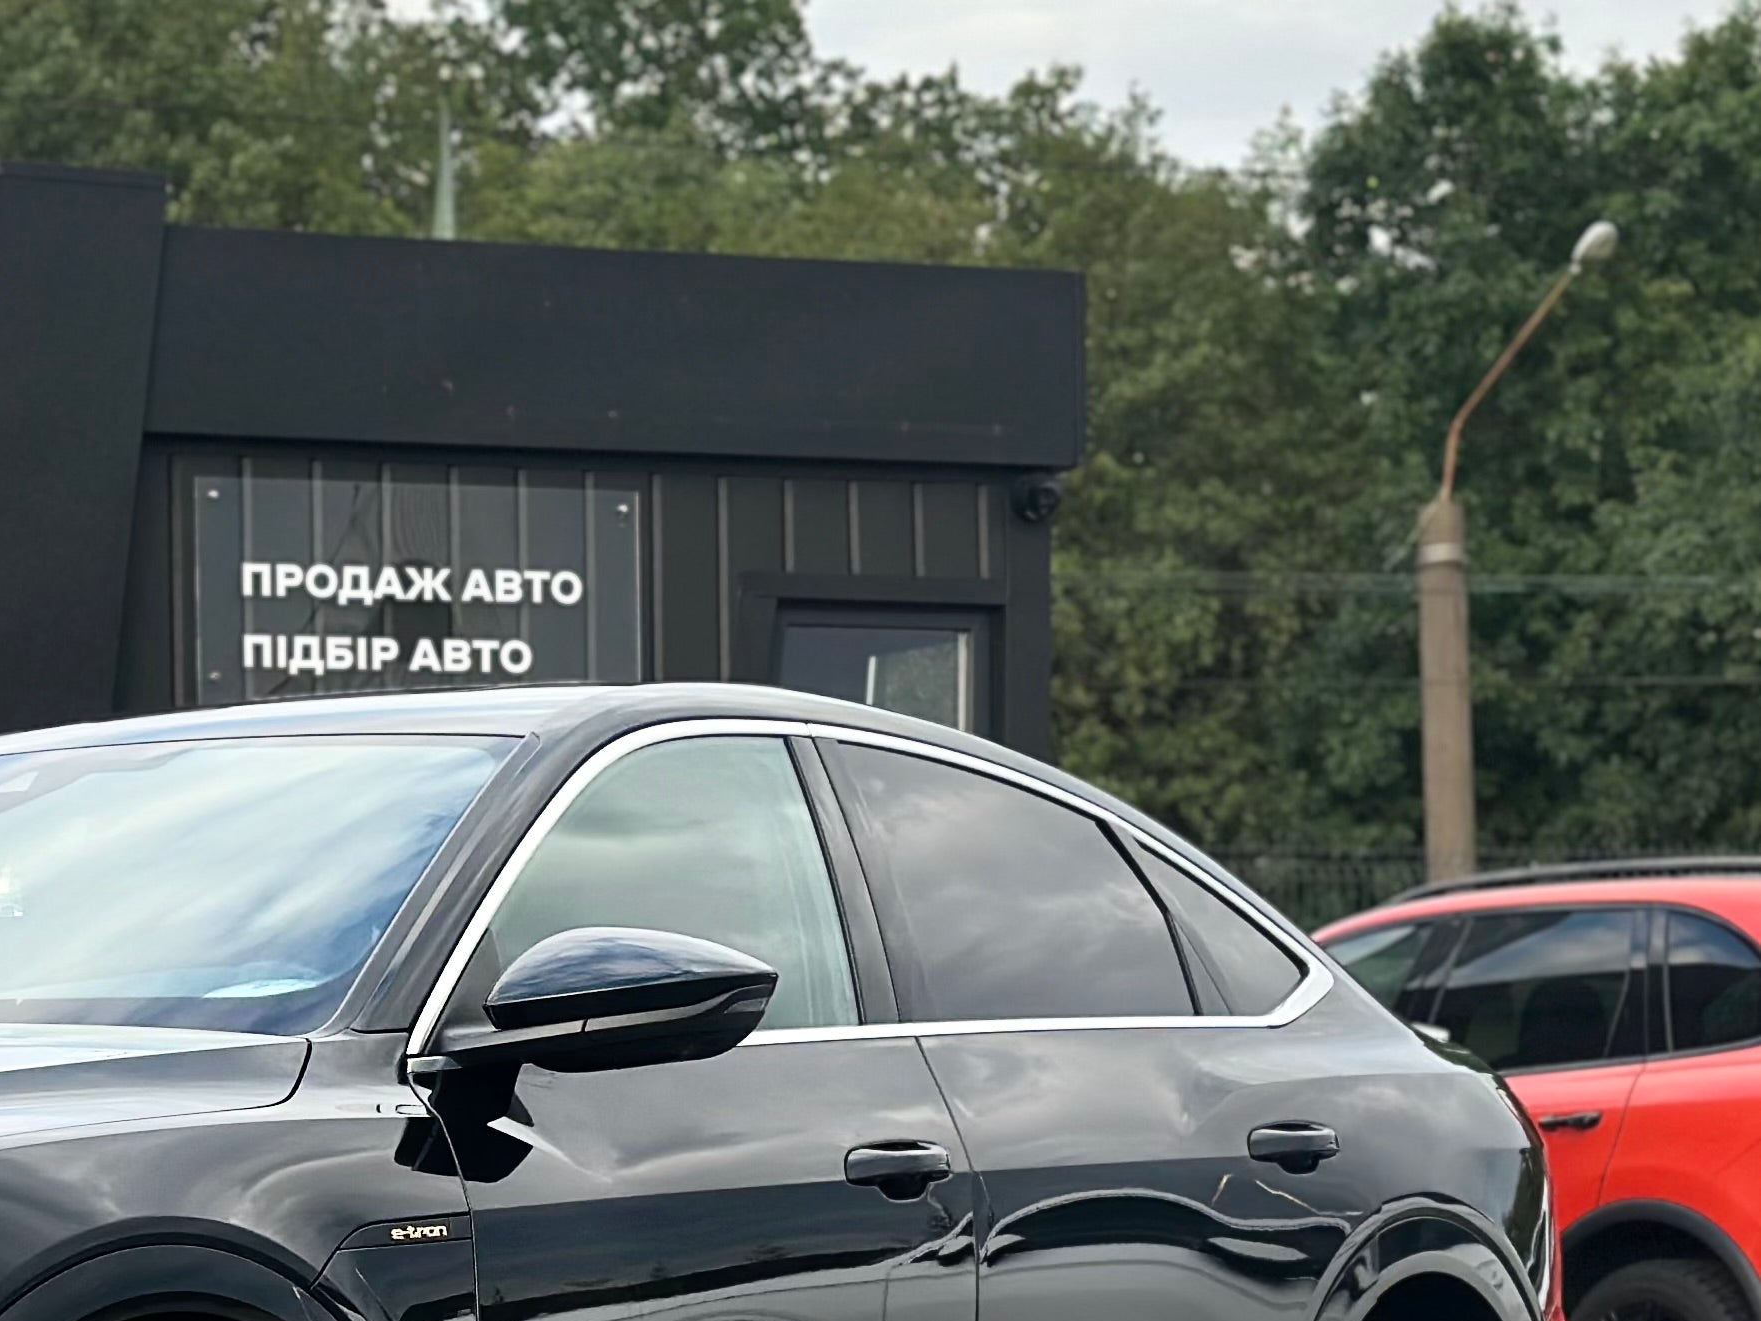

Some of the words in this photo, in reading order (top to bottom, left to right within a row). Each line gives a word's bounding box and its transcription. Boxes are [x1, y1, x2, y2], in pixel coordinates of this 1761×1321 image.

[241, 560, 453, 607] ПРОДАЖ
[460, 567, 585, 606] АВТО
[242, 632, 400, 677] ПІДБІР
[407, 637, 535, 675] АВТО
[390, 1225, 448, 1240] e-tron
